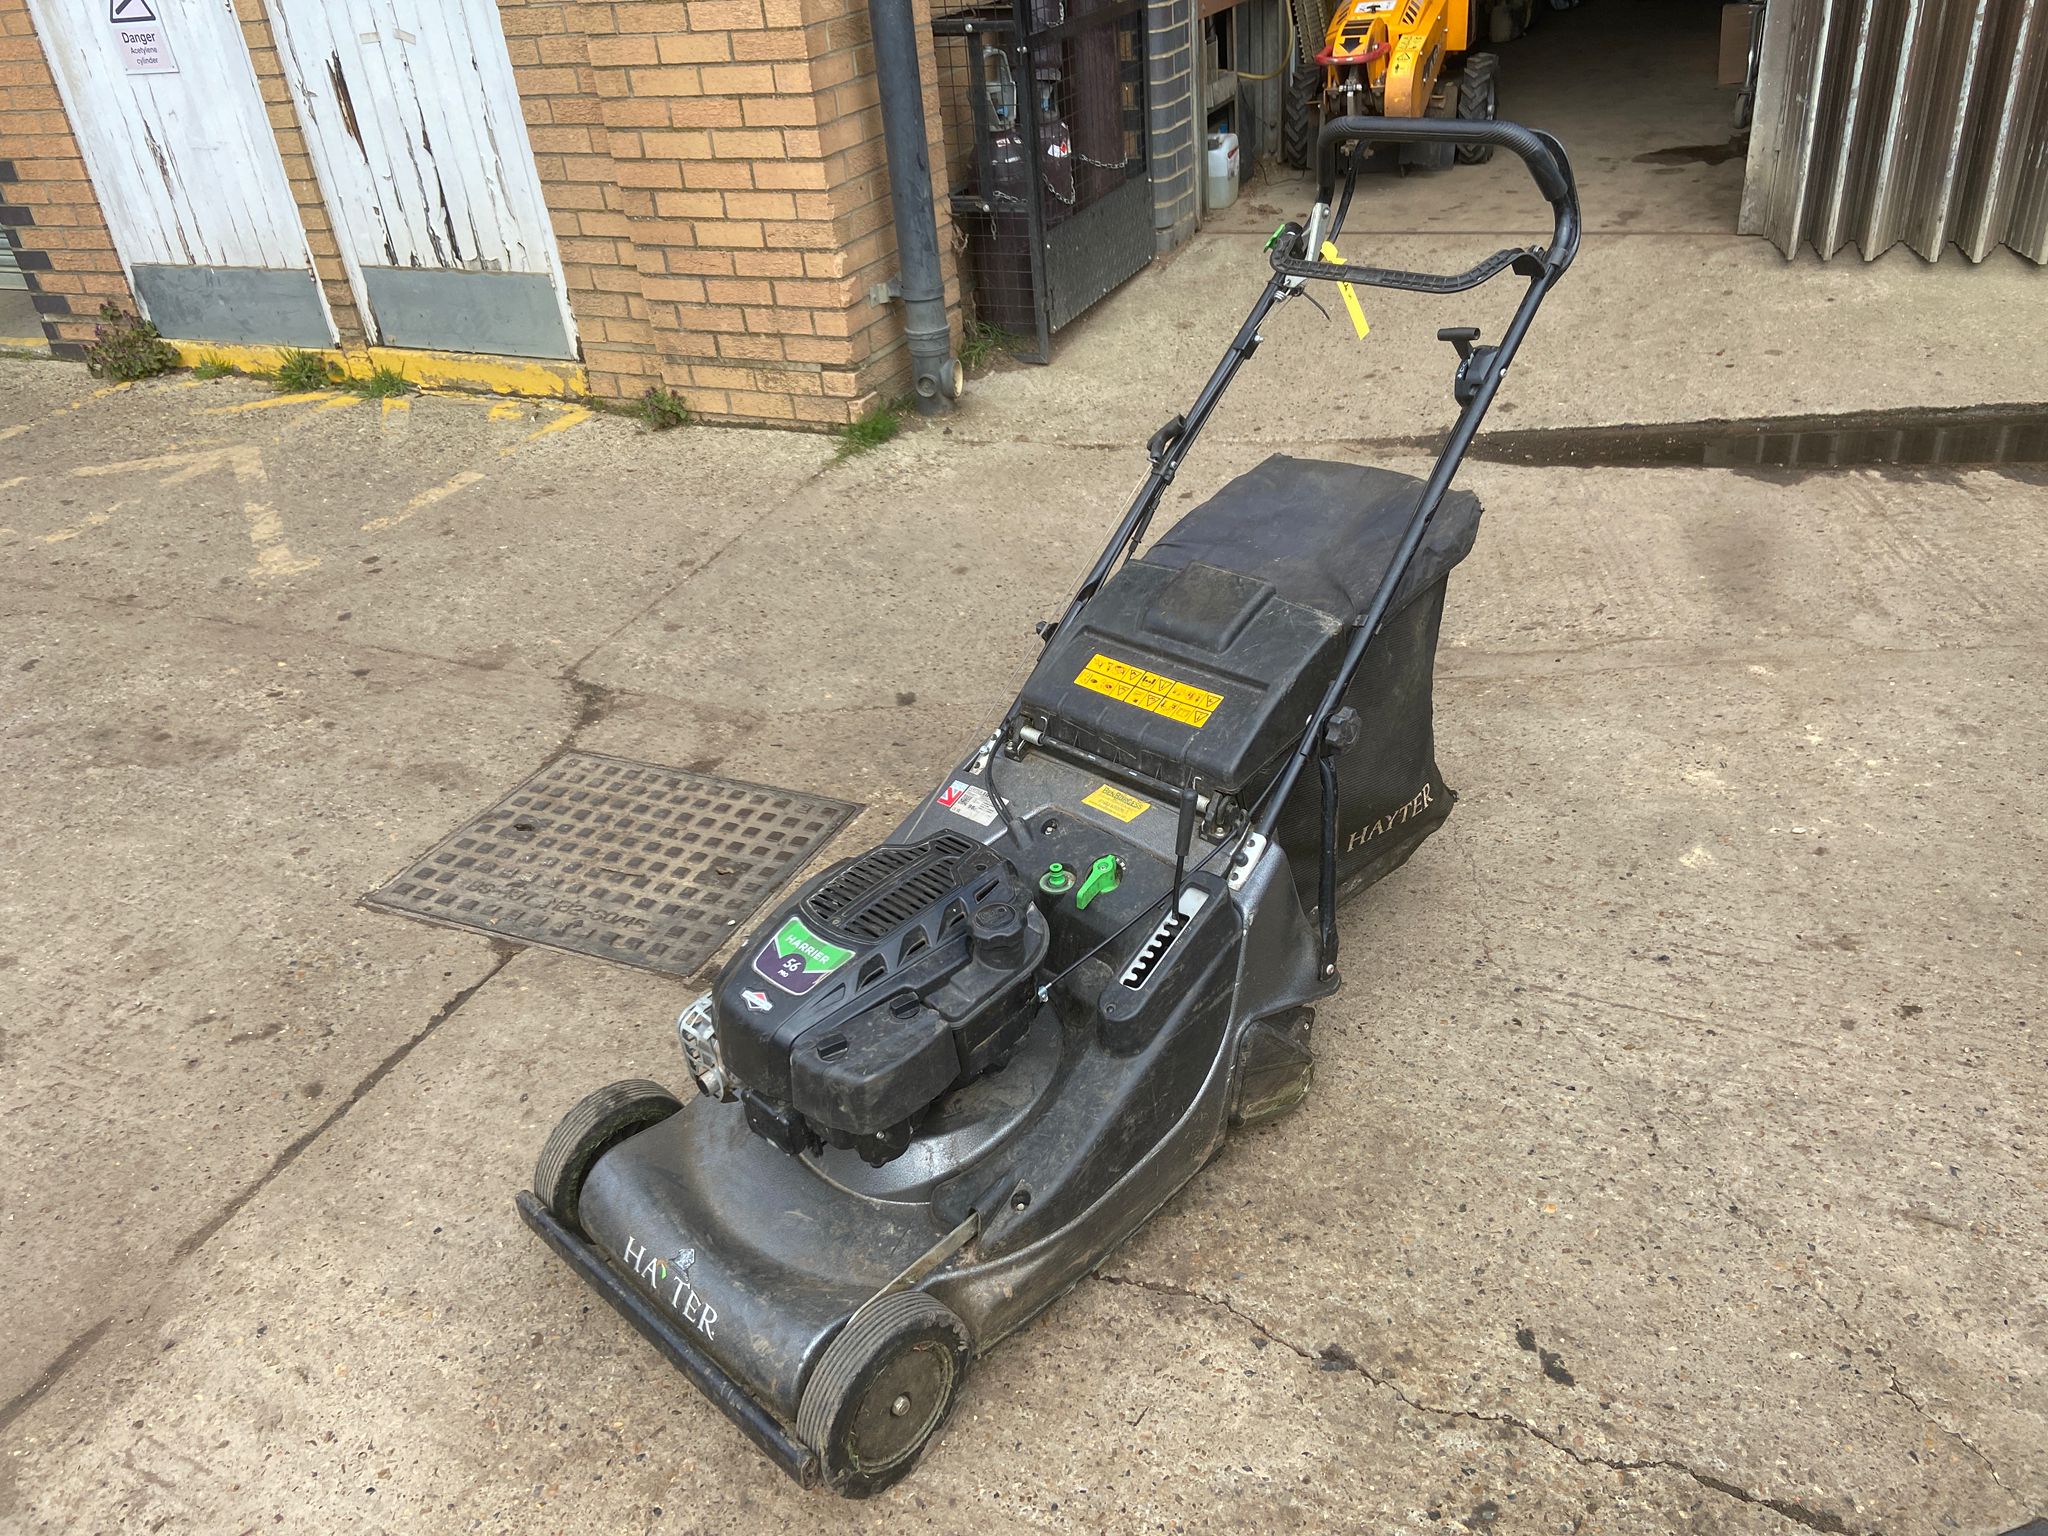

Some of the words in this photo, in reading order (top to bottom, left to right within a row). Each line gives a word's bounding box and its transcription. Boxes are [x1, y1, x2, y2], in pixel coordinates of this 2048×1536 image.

[121, 32, 156, 45] Danger
[130, 46, 158, 55] Acetylene
[136, 57, 159, 66] cylinder
[1347, 782, 1434, 853] HAYTER
[784, 934, 831, 965] HARRIER
[782, 958, 802, 972] 56
[623, 1235, 719, 1341] HATER
